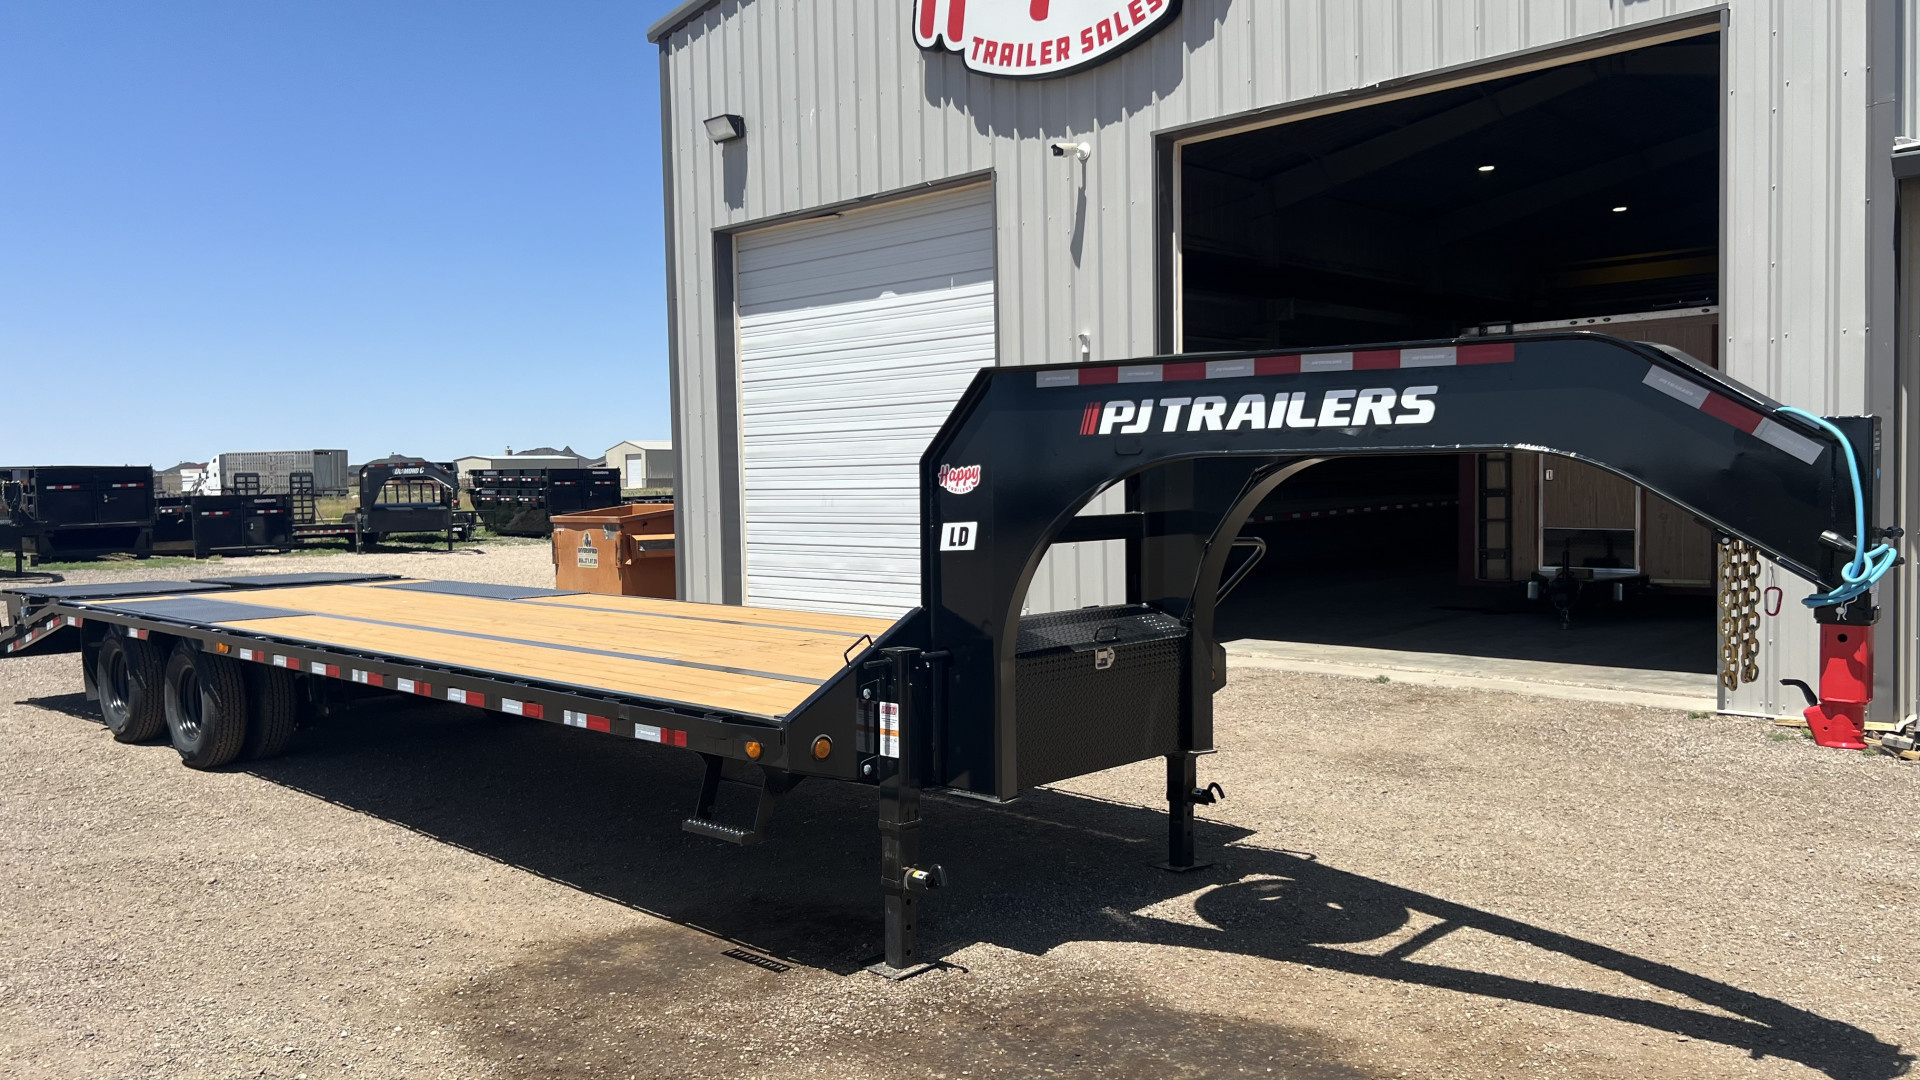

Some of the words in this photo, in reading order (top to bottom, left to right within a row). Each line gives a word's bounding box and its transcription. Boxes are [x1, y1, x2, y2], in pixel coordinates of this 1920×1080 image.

[972, 36, 1070, 68] TRAILER
[1080, 0, 1163, 55] SALES
[1098, 398, 1154, 435] PJ
[1159, 385, 1439, 433] TRAILERS
[938, 464, 980, 488] Happy
[948, 526, 970, 547] LD
